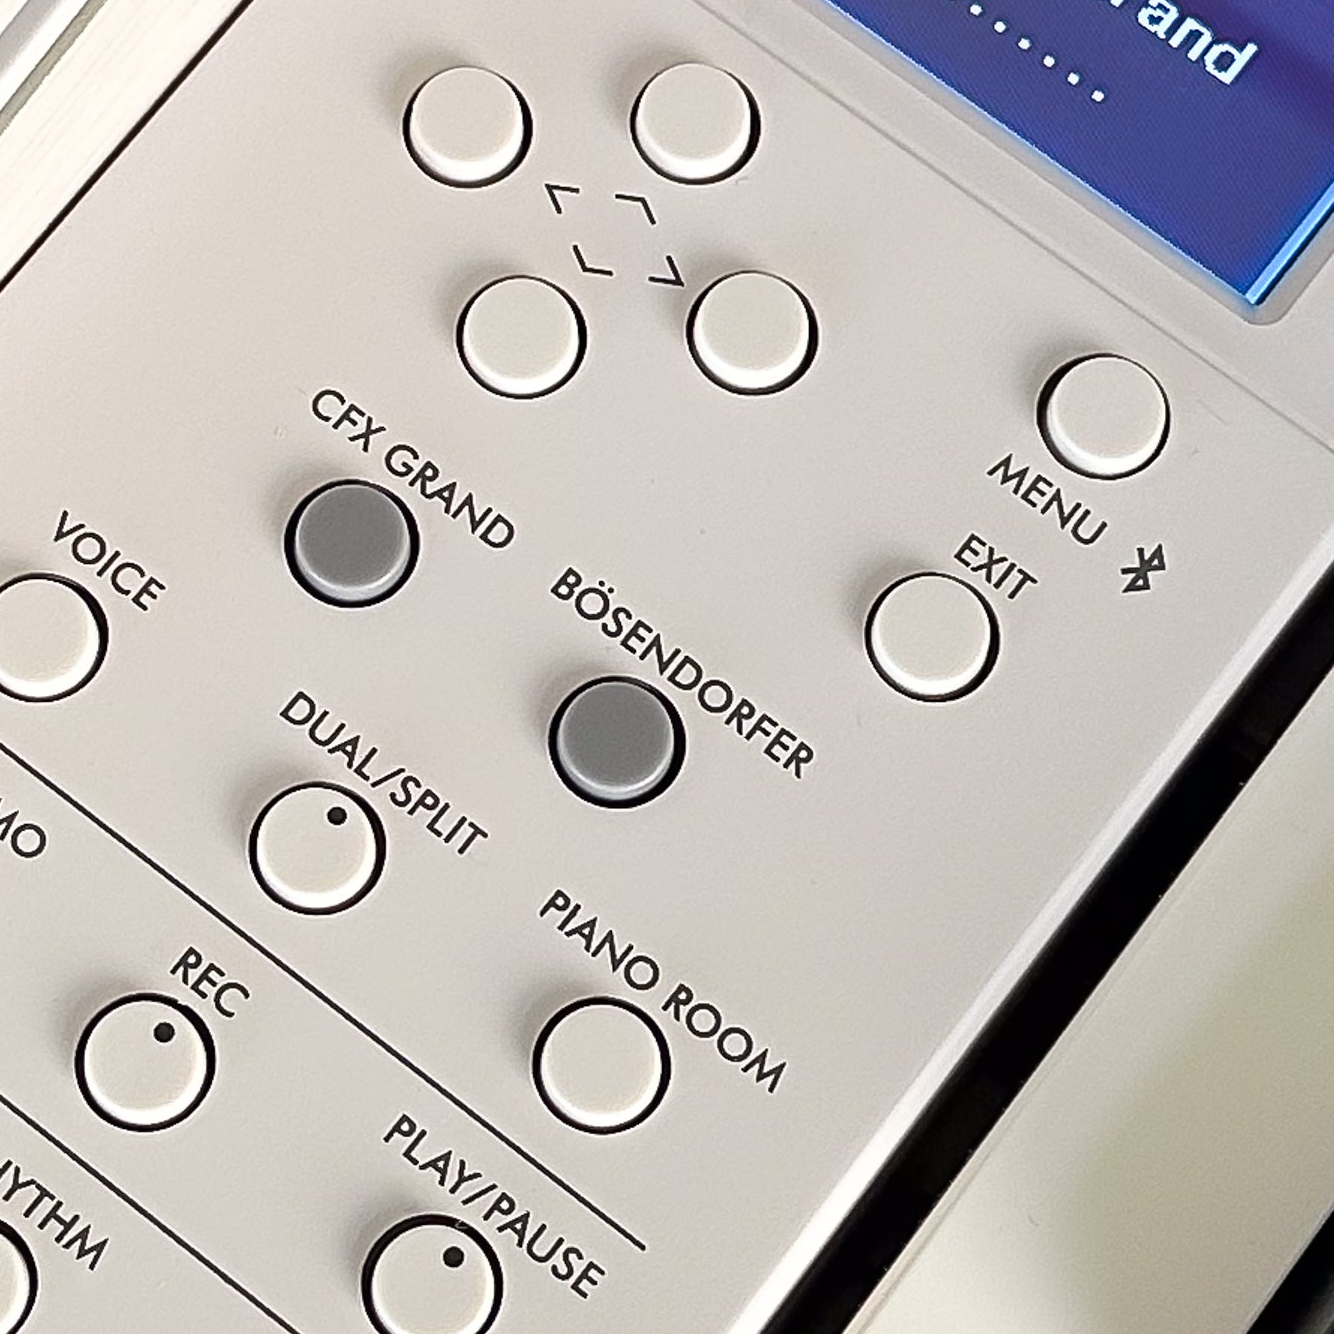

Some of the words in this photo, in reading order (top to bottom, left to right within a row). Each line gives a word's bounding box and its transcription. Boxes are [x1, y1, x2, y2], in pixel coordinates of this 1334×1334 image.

[310, 387, 387, 451] CFX
[384, 442, 515, 551] GRAND
[986, 453, 1109, 547] MENU
[53, 510, 166, 613] VOICE
[954, 534, 1038, 602] EXIT
[550, 566, 817, 780] BÖSENDORFER
[279, 691, 488, 857] DUAL/SPLIT
[169, 946, 251, 1020] REC
[539, 889, 661, 993] PIANO
[660, 983, 788, 1095] ROOM
[382, 1113, 606, 1301] PLAY/PAUSE
